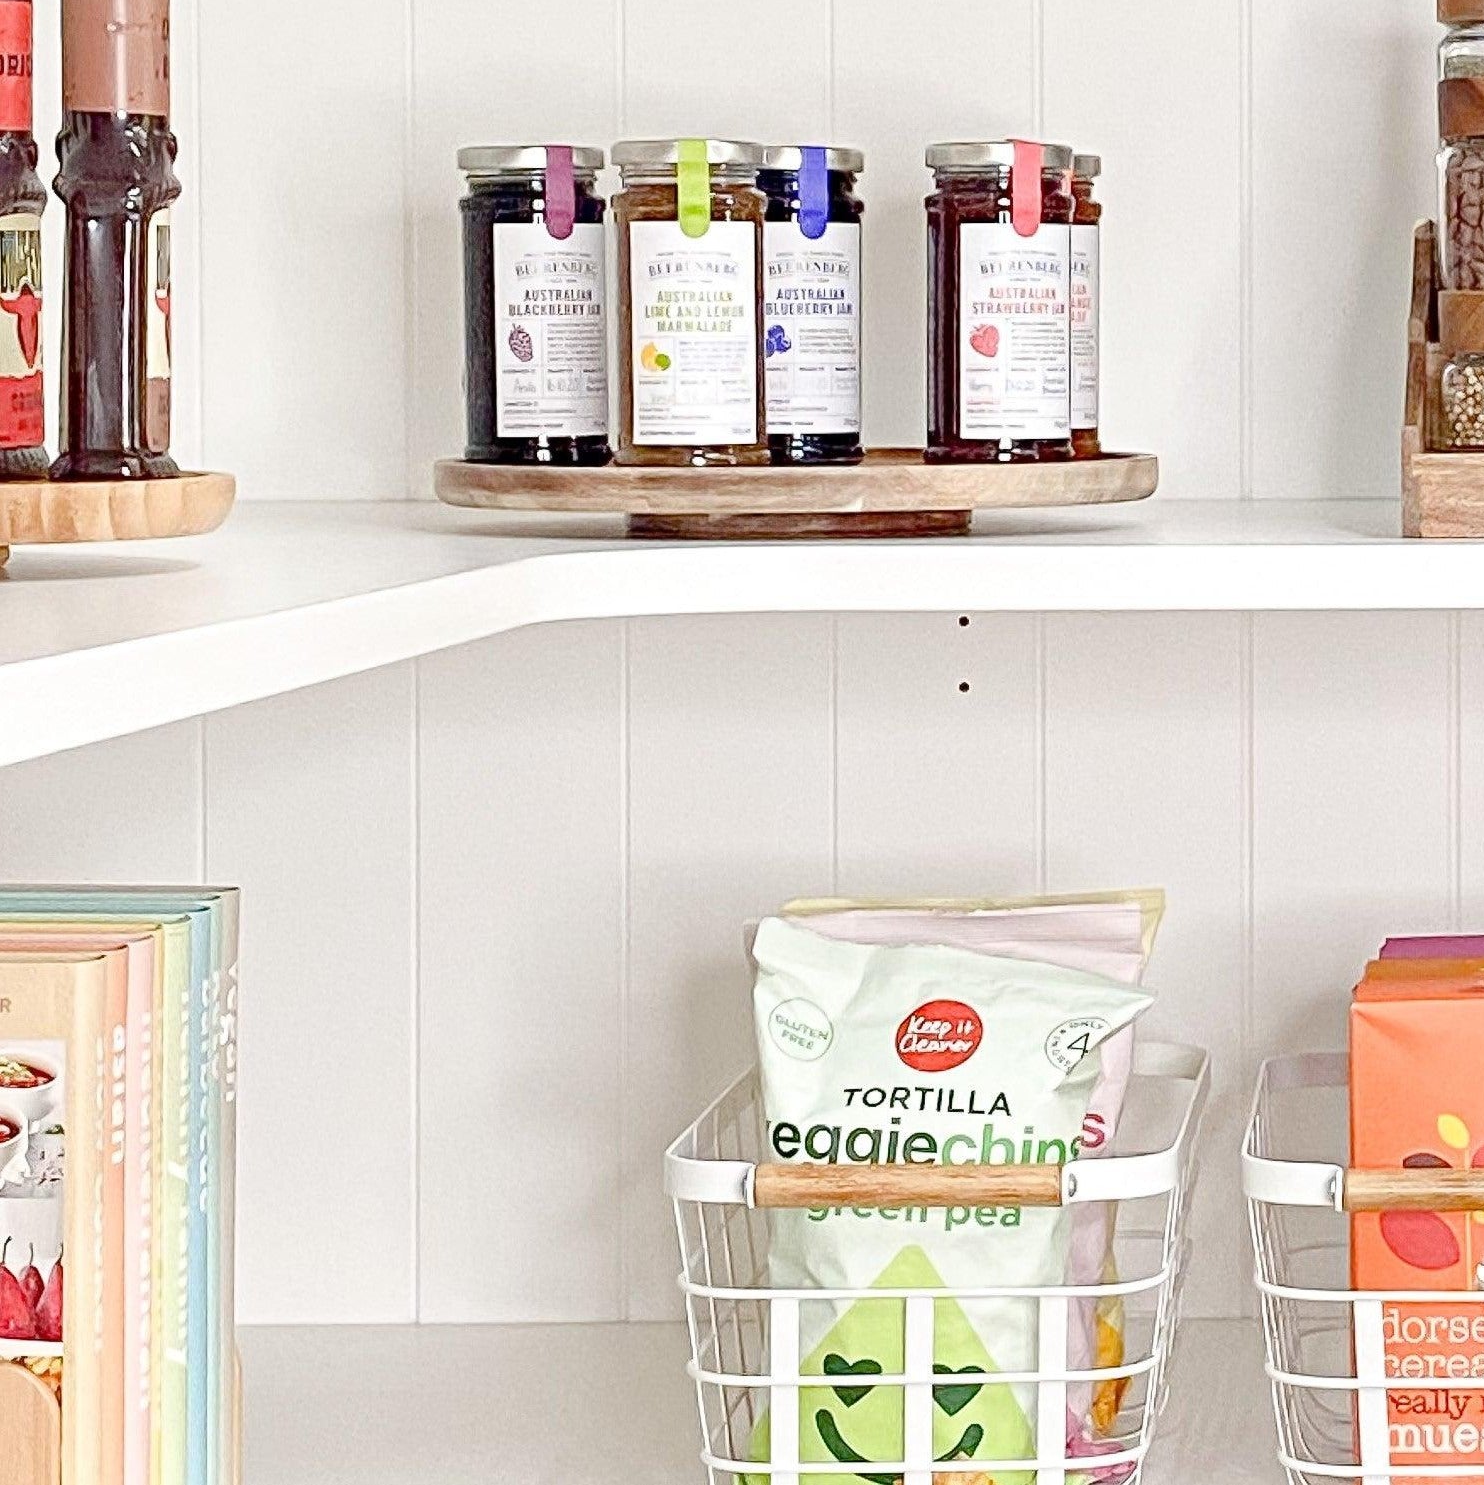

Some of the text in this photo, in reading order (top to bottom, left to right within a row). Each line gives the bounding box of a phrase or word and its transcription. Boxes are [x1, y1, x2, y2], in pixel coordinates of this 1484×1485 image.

[775, 1014, 829, 1041] GLUTEN
[781, 1029, 814, 1050] FREE
[907, 1015, 953, 1039] Keep
[844, 1087, 1011, 1116] TORTILLA
